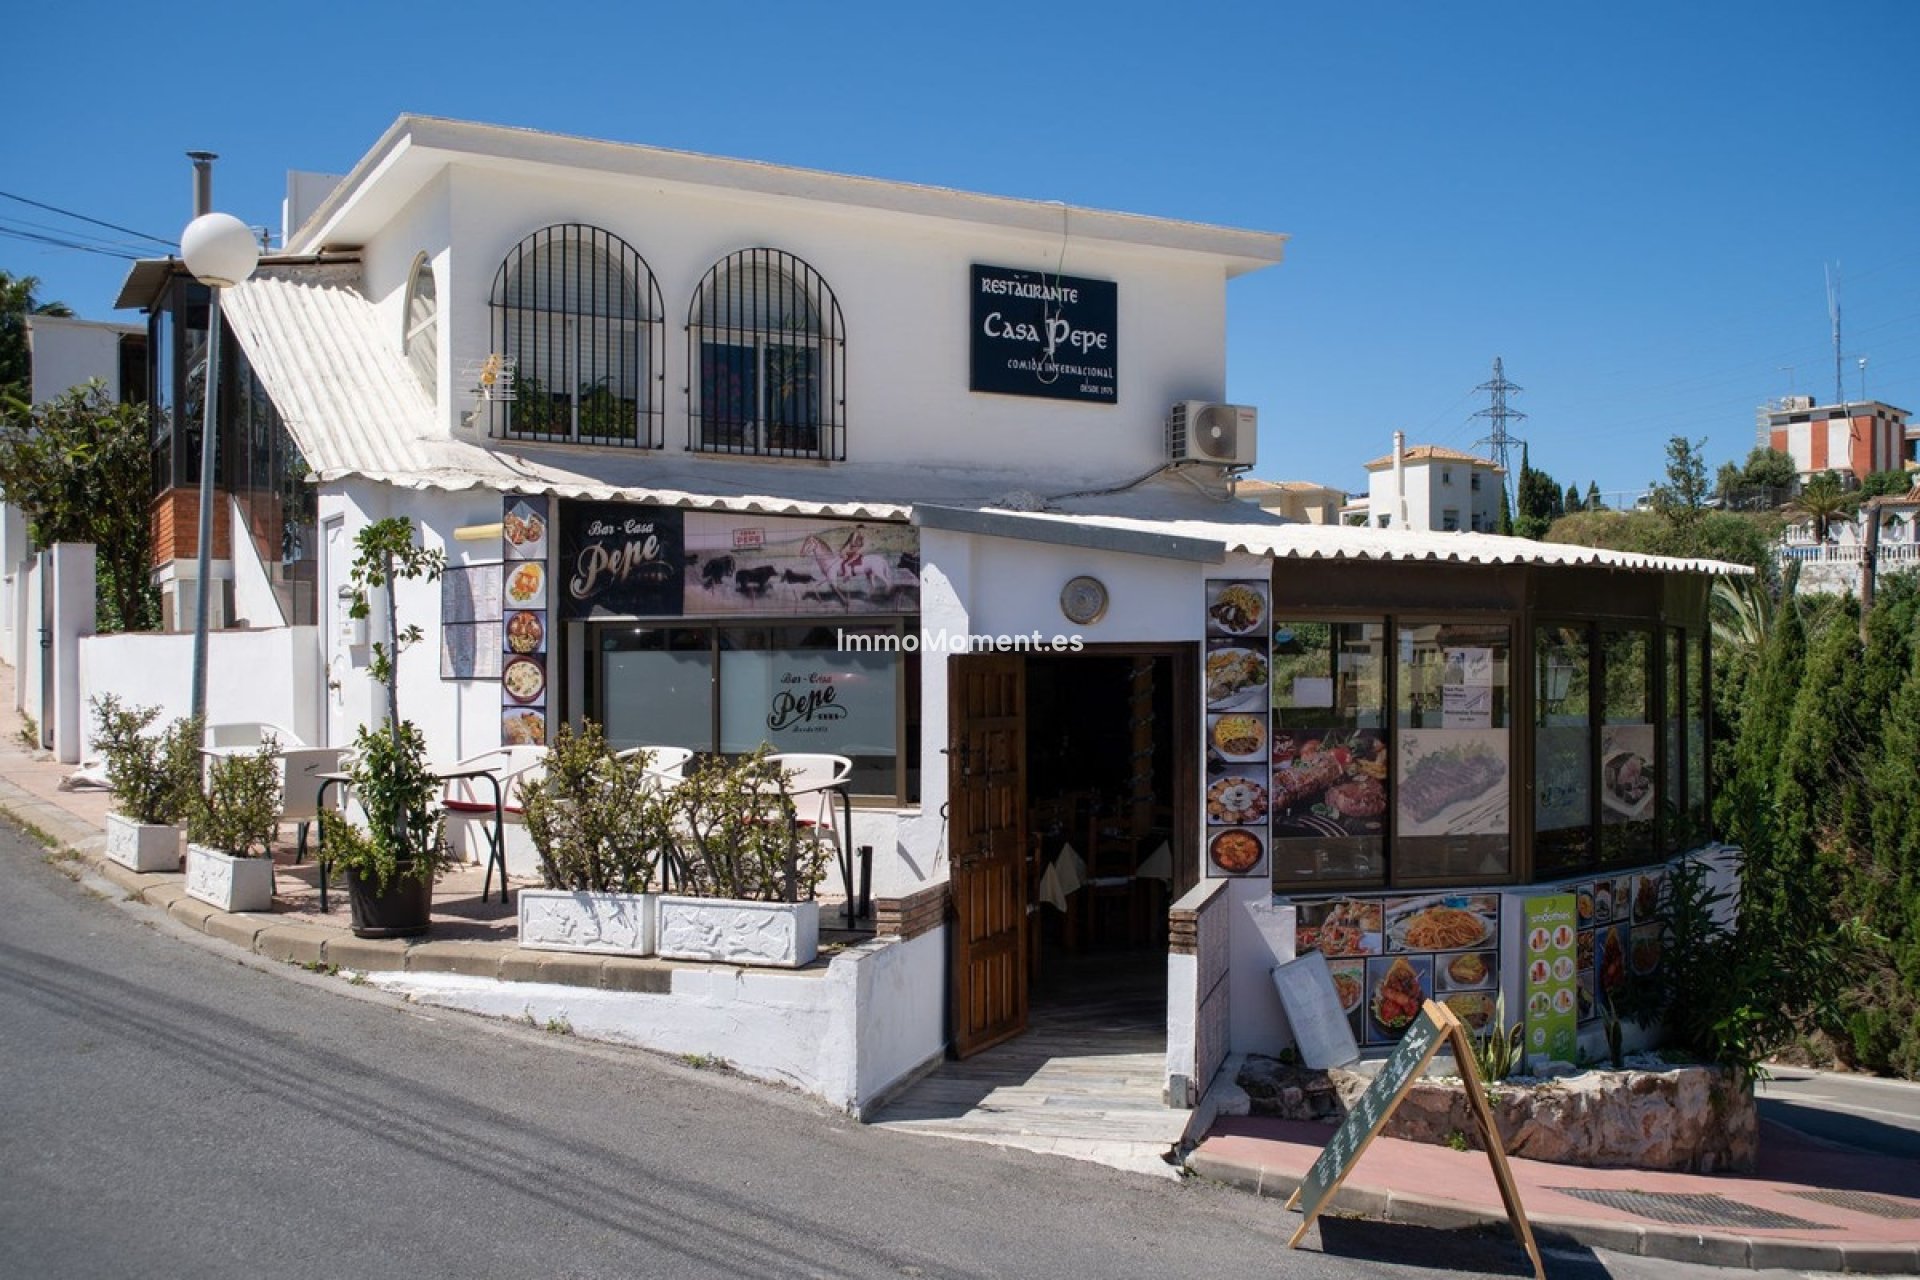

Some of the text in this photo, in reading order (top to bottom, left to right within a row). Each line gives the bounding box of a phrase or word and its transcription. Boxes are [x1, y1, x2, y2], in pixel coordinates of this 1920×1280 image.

[982, 277, 1078, 303] RESTAURANTE
[1044, 362, 1114, 379] INTERNACIONAL
[588, 520, 615, 536] Bar
[624, 519, 654, 534] Casa
[570, 534, 661, 599] Pepe
[767, 686, 837, 731] Pepe
